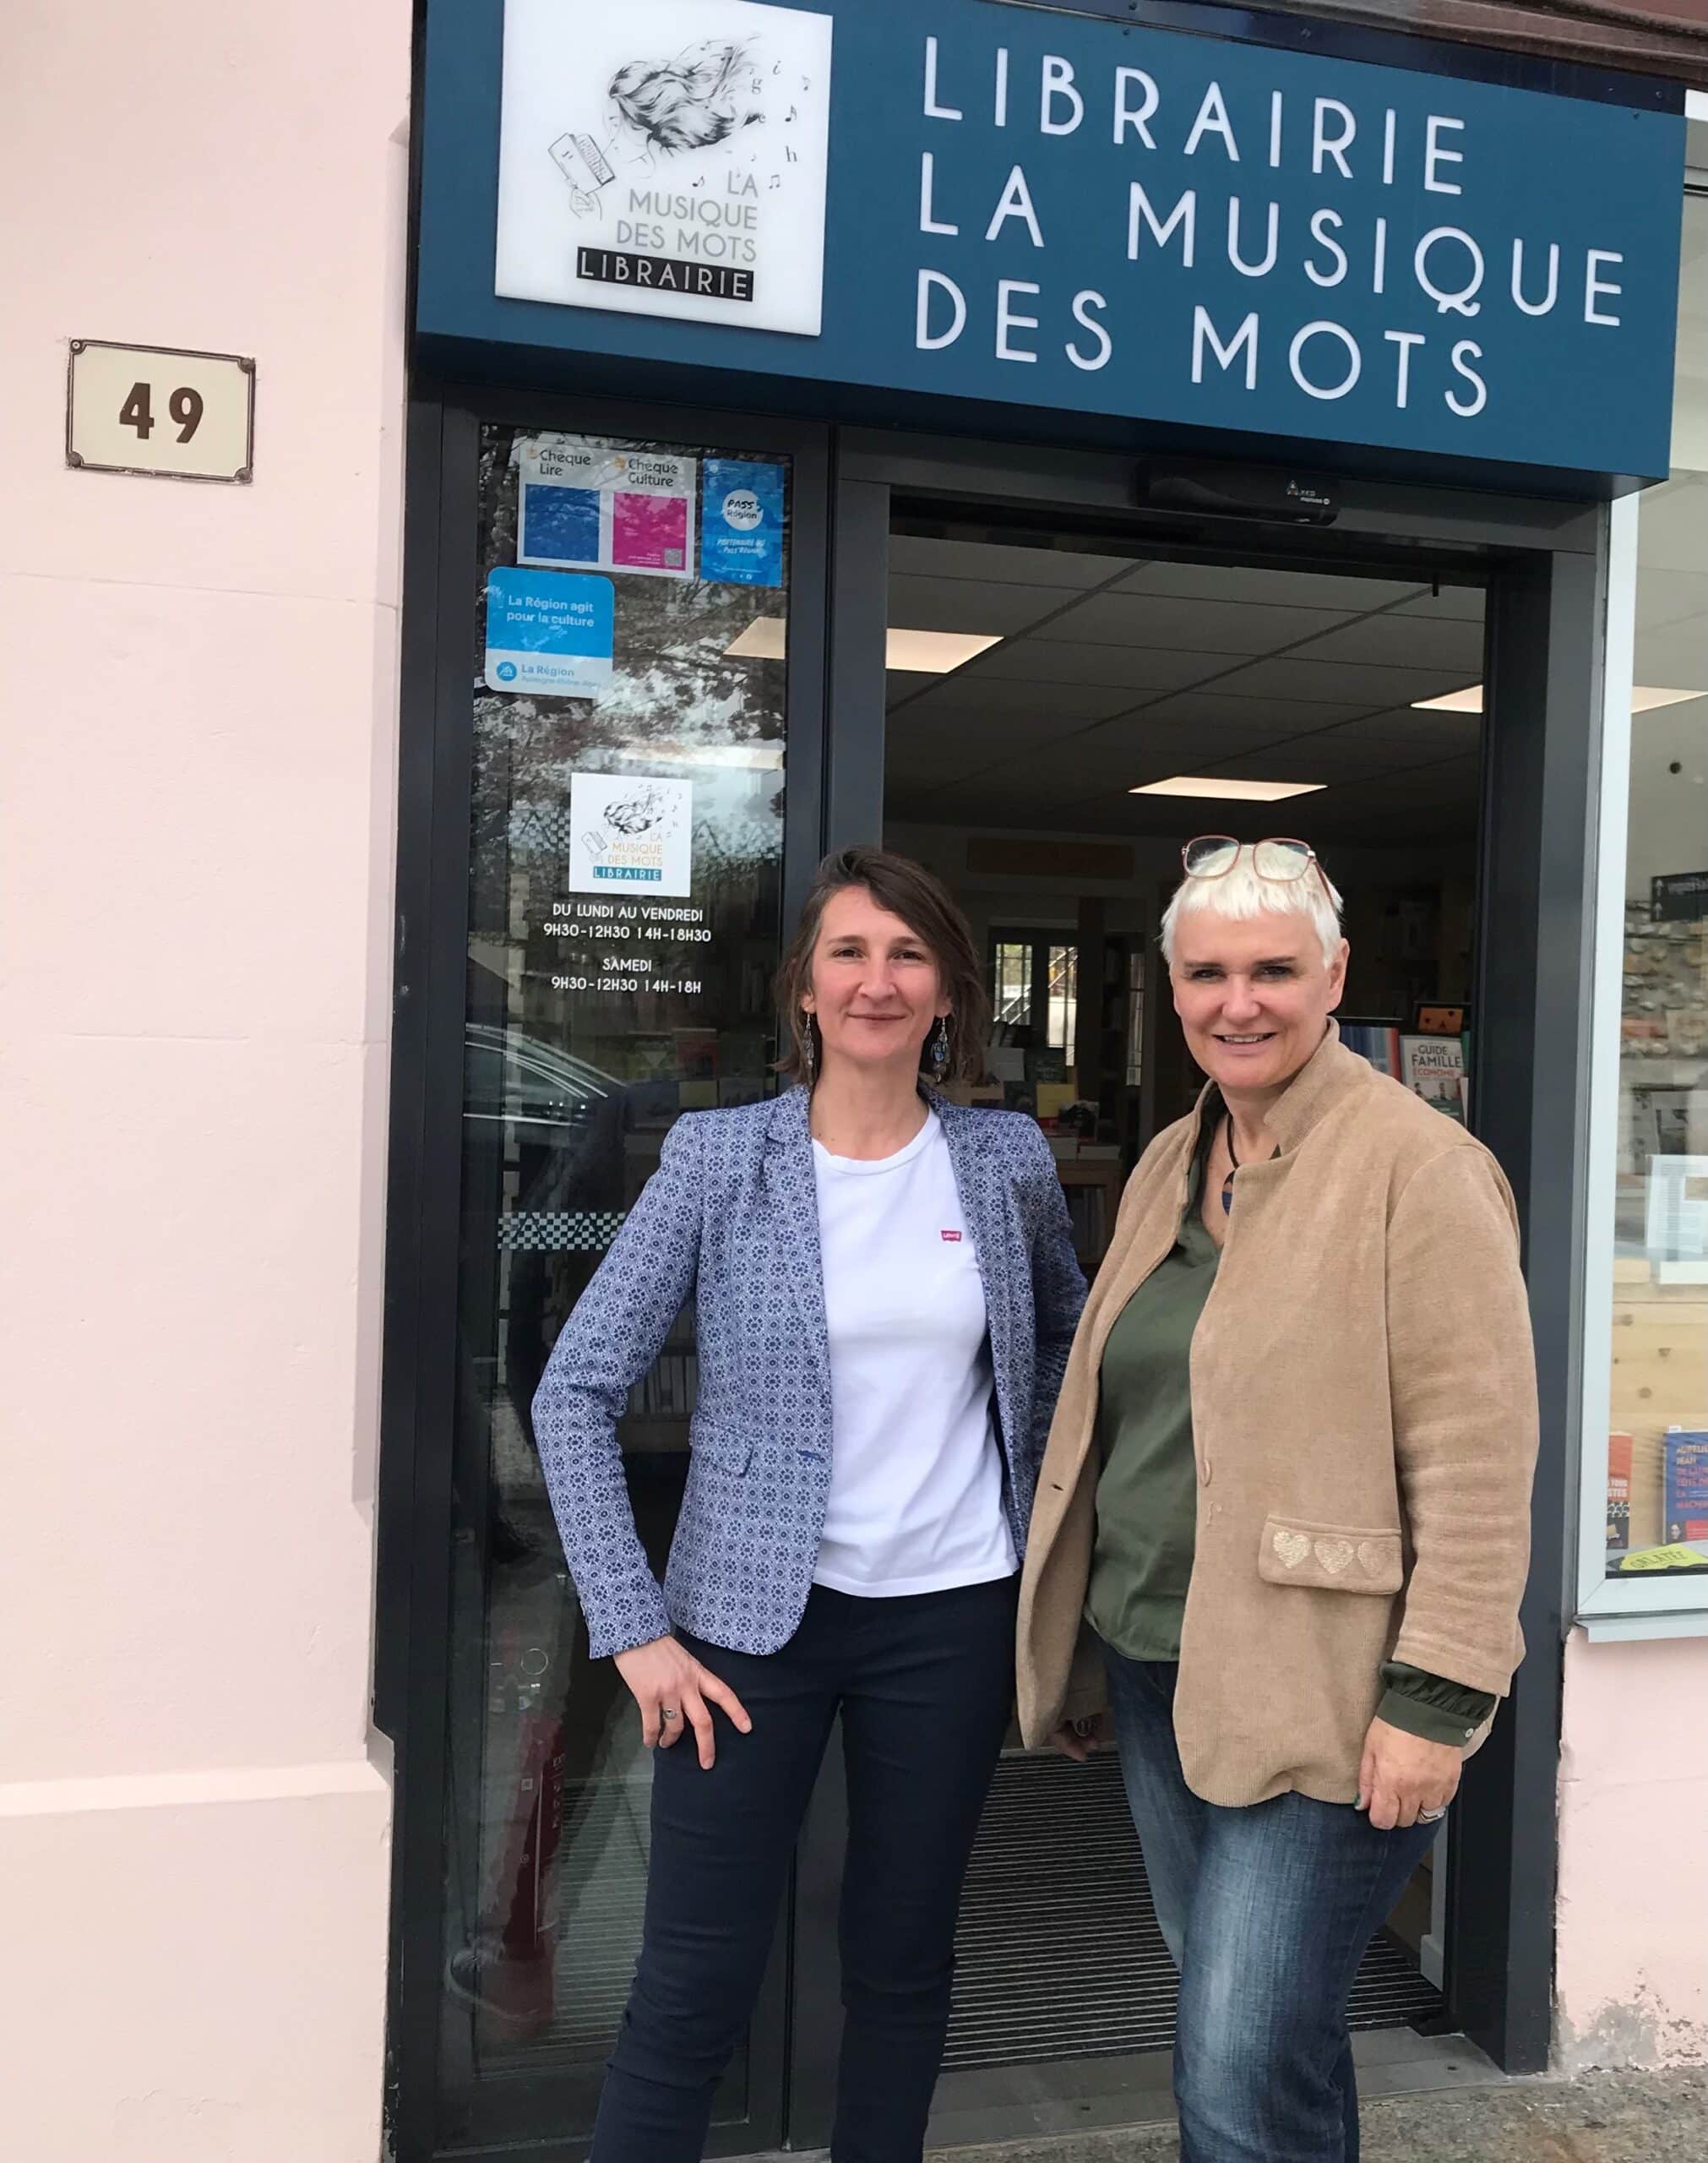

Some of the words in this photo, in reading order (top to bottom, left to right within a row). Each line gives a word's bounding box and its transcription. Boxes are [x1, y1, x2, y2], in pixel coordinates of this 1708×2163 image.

[922, 35, 1466, 196] LIBRAIRIE
[727, 170, 759, 199] LA
[628, 188, 758, 230] MUSIQUE
[617, 221, 666, 248] DES
[677, 228, 757, 263] MOTS
[919, 151, 1045, 248] LA
[1127, 181, 1624, 327] MUSIQUE
[580, 251, 748, 297] LIBRAIRIE
[915, 269, 1113, 372] DES
[1191, 304, 1488, 417] MOTS
[119, 382, 204, 444] 49
[539, 463, 563, 477] Lire
[628, 471, 674, 487] Culture
[509, 595, 523, 606] La
[525, 597, 568, 612] Région
[570, 601, 594, 614] agit
[507, 612, 536, 623] pour
[538, 612, 549, 624] la
[552, 615, 595, 628] culture
[521, 664, 535, 674] La
[536, 665, 574, 678] Région
[650, 832, 663, 842] LA
[612, 842, 663, 855] MUSIQUE
[608, 854, 628, 865] DES
[631, 856, 663, 867] MOTS
[594, 867, 660, 880] LIBRAIRIE
[552, 903, 571, 916] DU
[576, 904, 614, 918] LUNDI
[618, 907, 638, 919] AU
[640, 907, 704, 922] VENDREDI
[543, 923, 630, 940] 9H30-12H30
[637, 926, 712, 942] 14H-18H30
[601, 957, 652, 972] SAMEDI
[551, 977, 639, 992] 9H30-12H30
[644, 979, 702, 994] 14H-18H
[1418, 1044, 1449, 1056] GUIDE
[1412, 1054, 1461, 1069] FAMILLE
